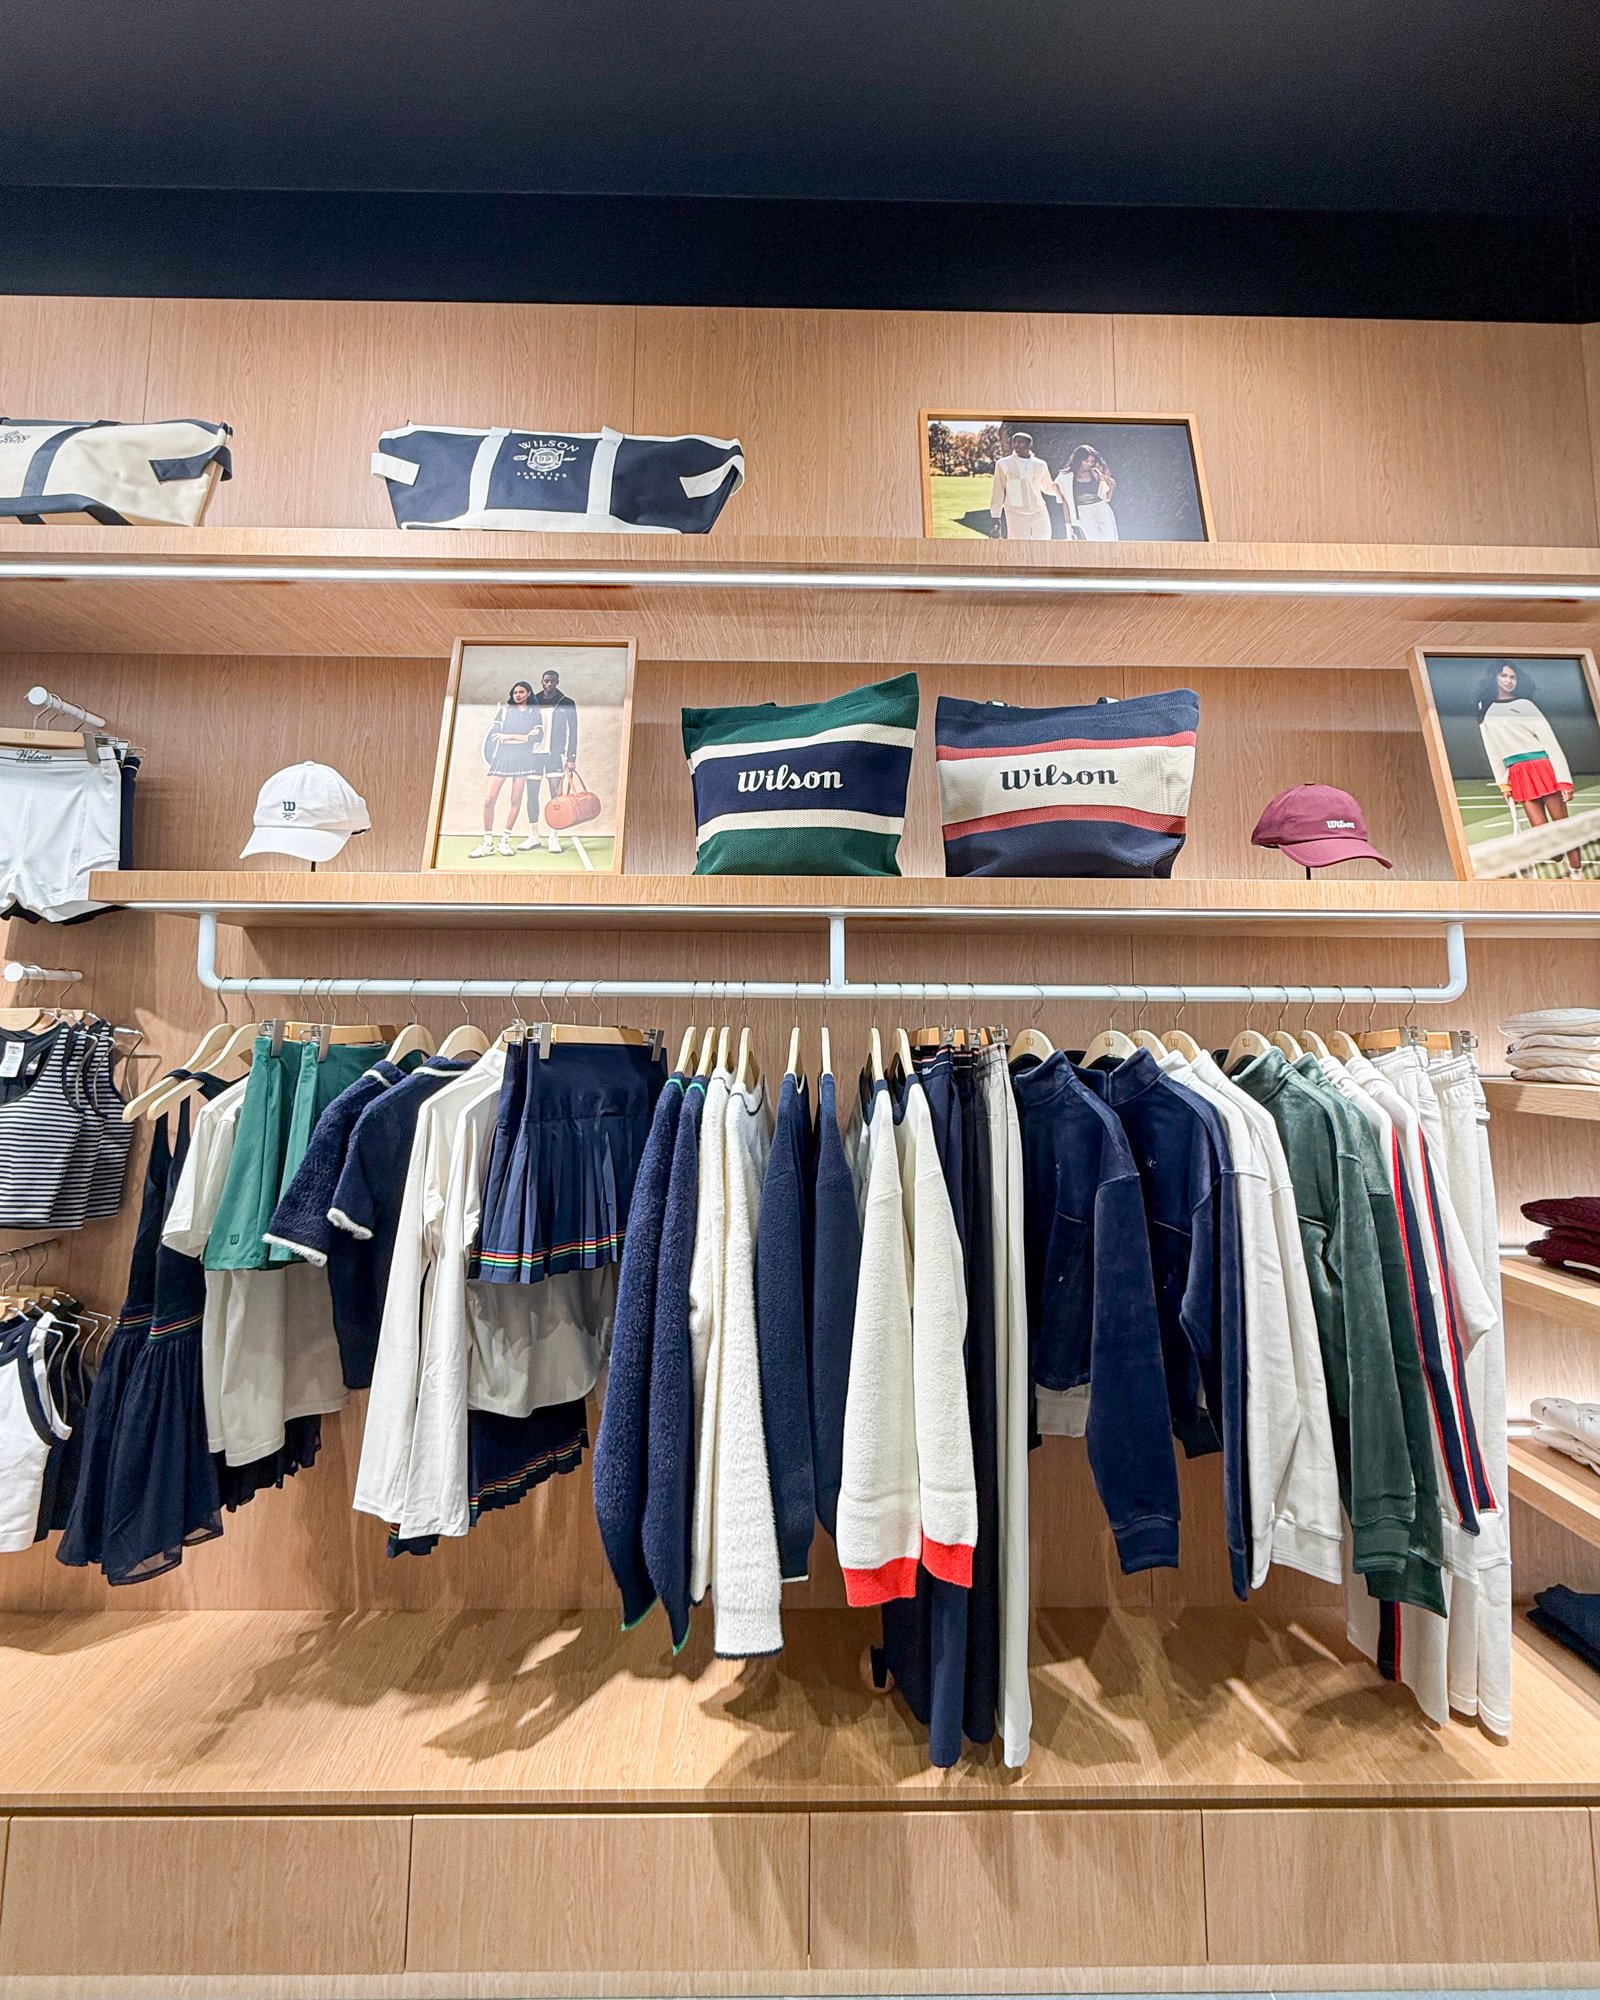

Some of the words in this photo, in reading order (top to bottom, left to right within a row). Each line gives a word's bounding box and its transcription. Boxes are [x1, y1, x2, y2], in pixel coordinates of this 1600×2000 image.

[518, 440, 580, 453] WILSON
[16, 749, 53, 760] Wilson
[737, 764, 843, 792] Wilson
[1000, 764, 1118, 790] Wilson
[282, 801, 296, 811] W
[1326, 820, 1355, 829] Wilson
